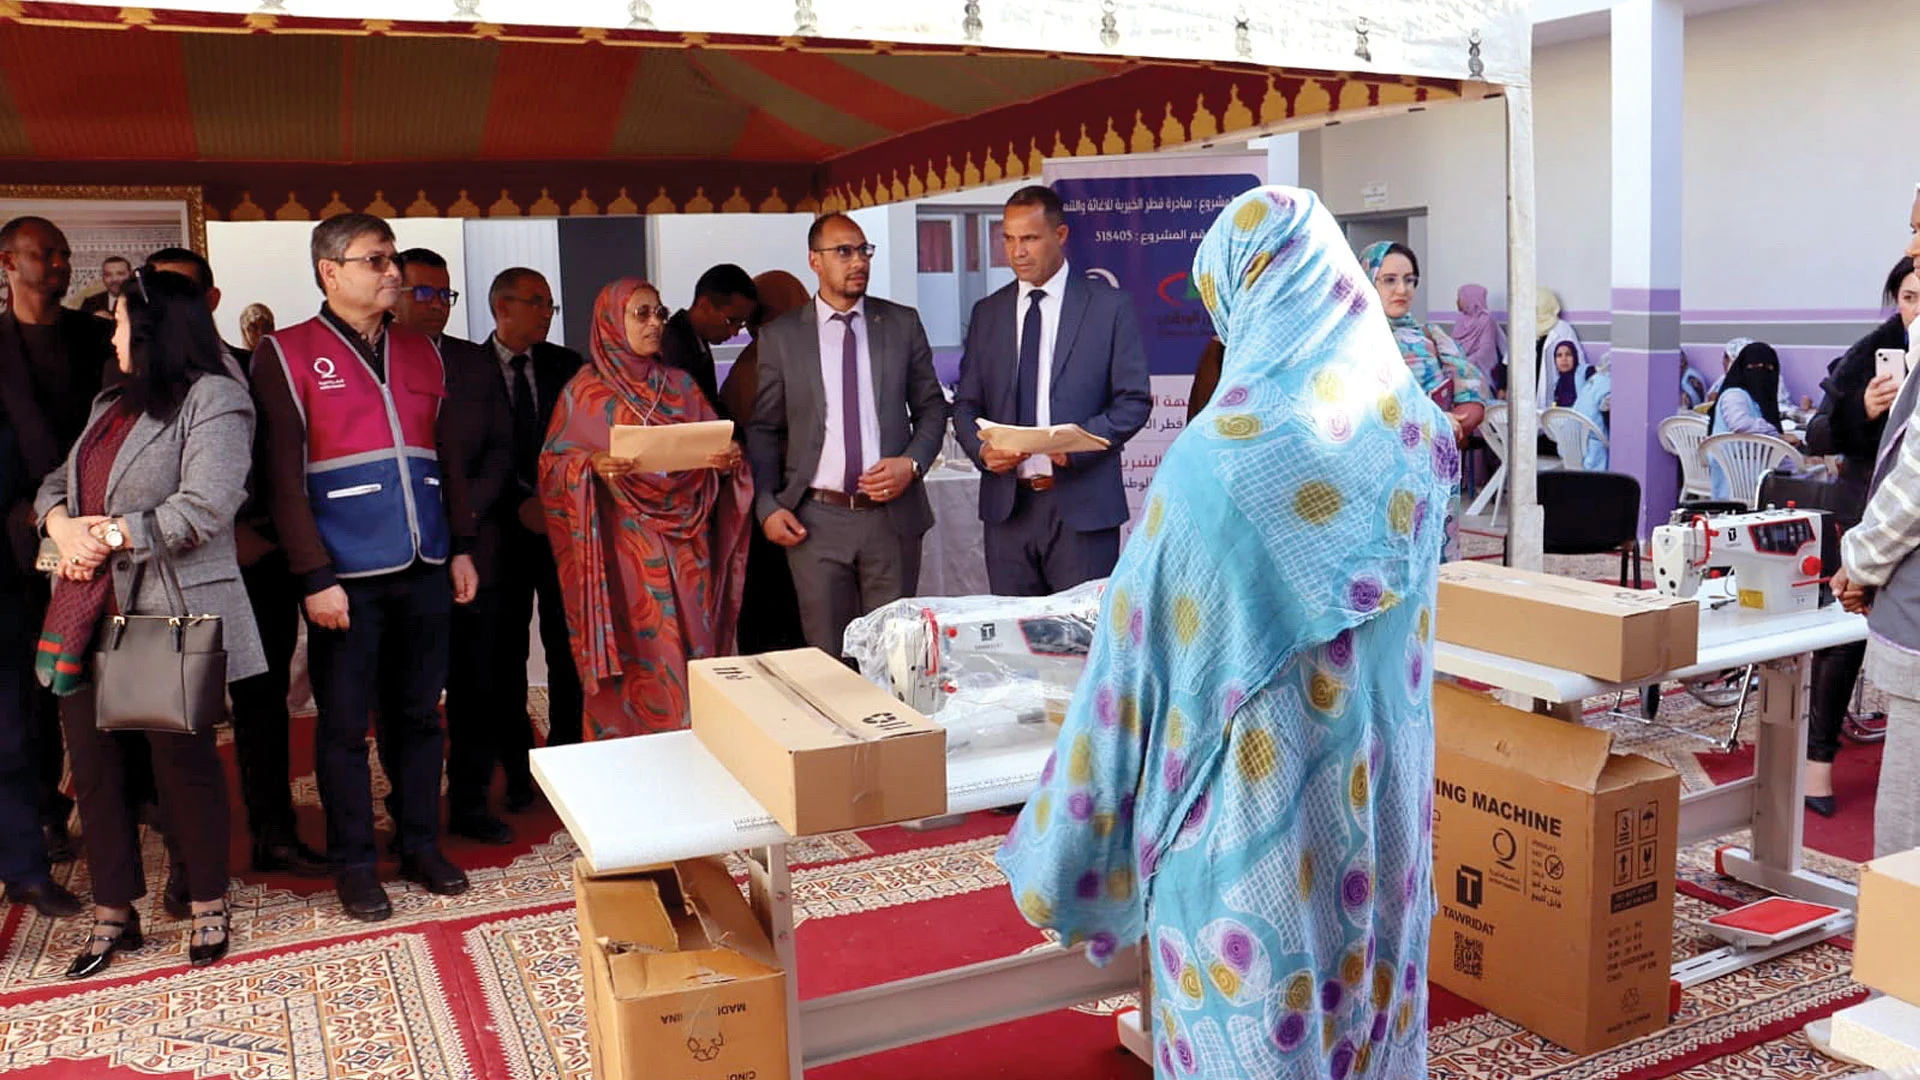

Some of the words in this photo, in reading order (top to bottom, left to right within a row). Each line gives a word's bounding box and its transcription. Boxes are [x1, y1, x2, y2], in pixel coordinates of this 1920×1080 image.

[1114, 197, 1143, 214] الخيرية
[1144, 197, 1163, 214] قطر
[1095, 230, 1133, 242] 518405
[1140, 229, 1186, 245] المشروع
[1159, 417, 1183, 433] قطر
[1435, 778, 1467, 804] ING
[1472, 791, 1562, 837] MACHINE
[1443, 905, 1496, 936] TAWRIDAT
[717, 1002, 746, 1016] MAD
